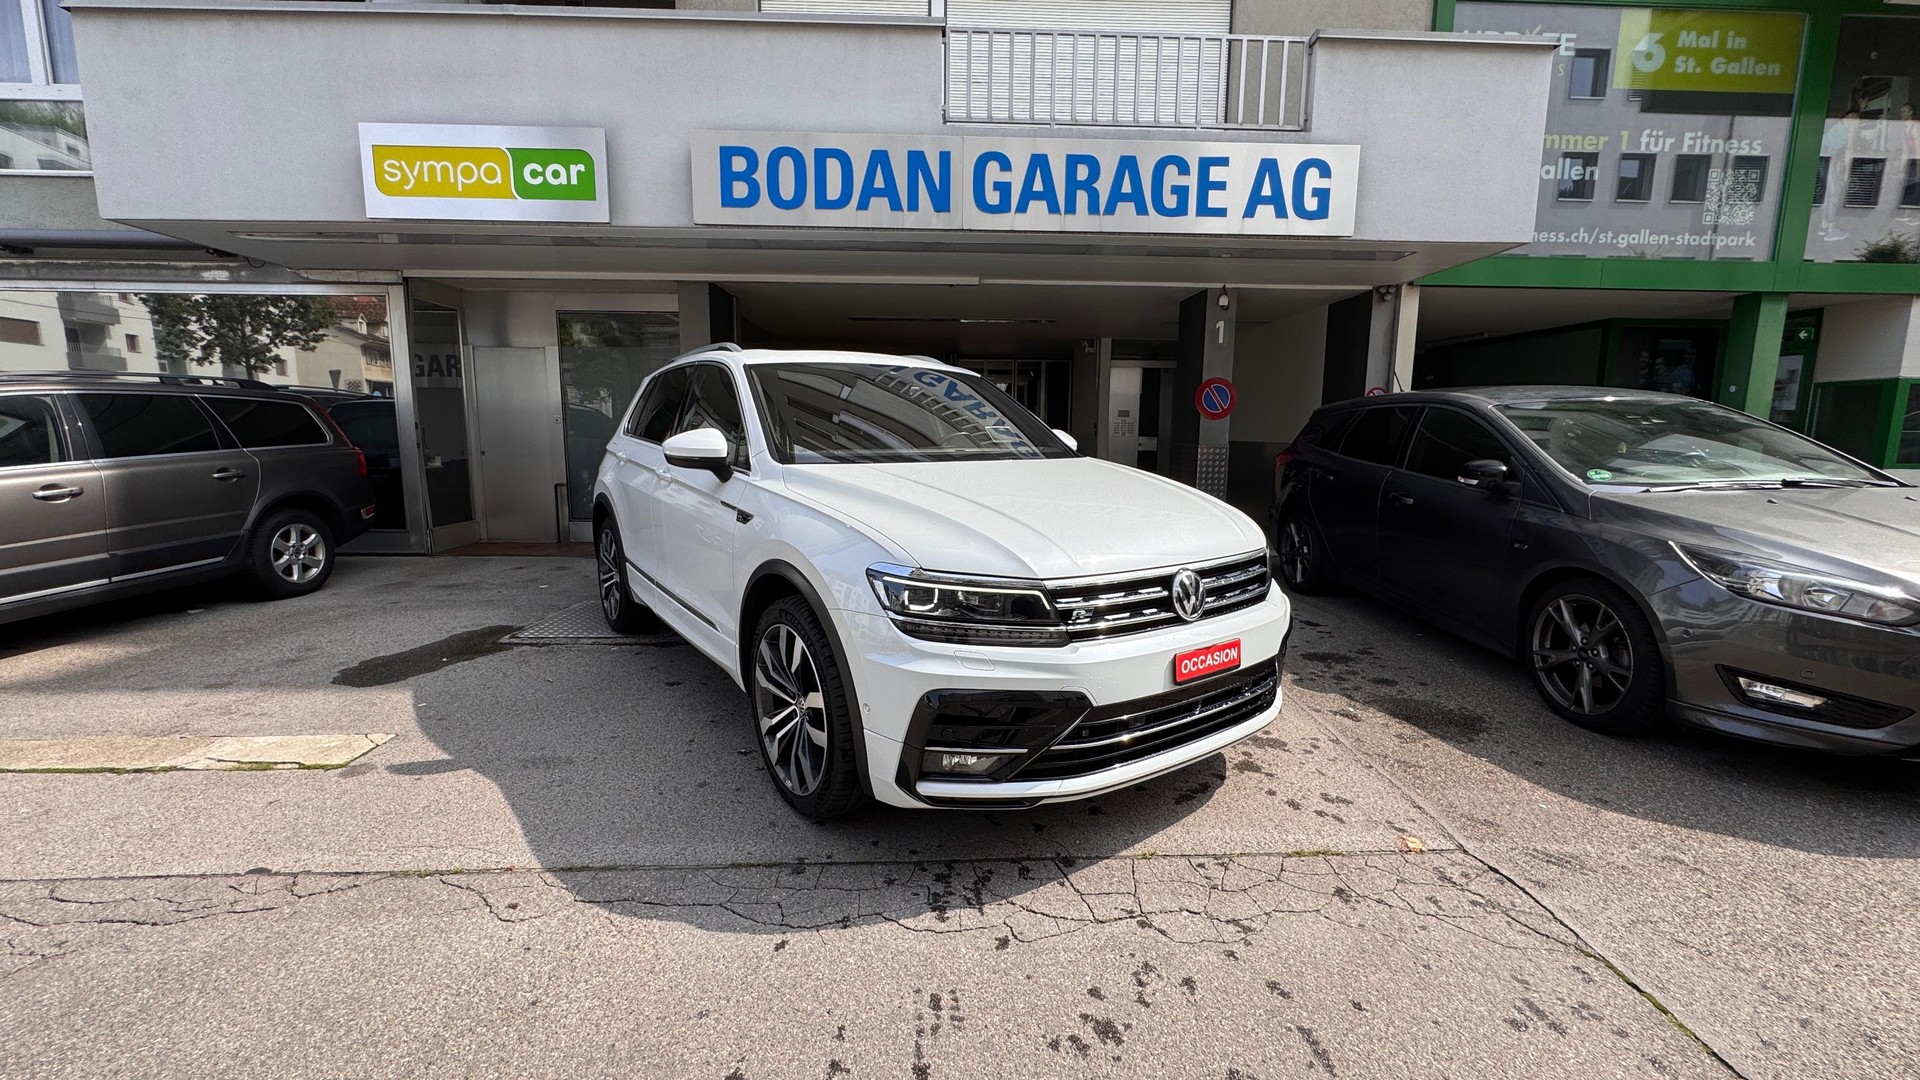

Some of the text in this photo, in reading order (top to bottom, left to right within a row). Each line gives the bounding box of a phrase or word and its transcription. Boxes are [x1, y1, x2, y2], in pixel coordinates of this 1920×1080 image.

[1677, 29, 1747, 50] Mal in
[1632, 33, 1666, 73] 6
[1674, 55, 1780, 77] St. Gallen
[1544, 128, 1763, 154] mmer 1 für Fitness
[383, 158, 586, 192] sympa car
[1540, 157, 1600, 180] allen
[719, 145, 1332, 221] BODAN GARAGE AG
[1531, 227, 1756, 248] ness.ch/st.gallen-stadtpark
[1216, 320, 1225, 344] 1
[1181, 647, 1239, 674] OCCASION
